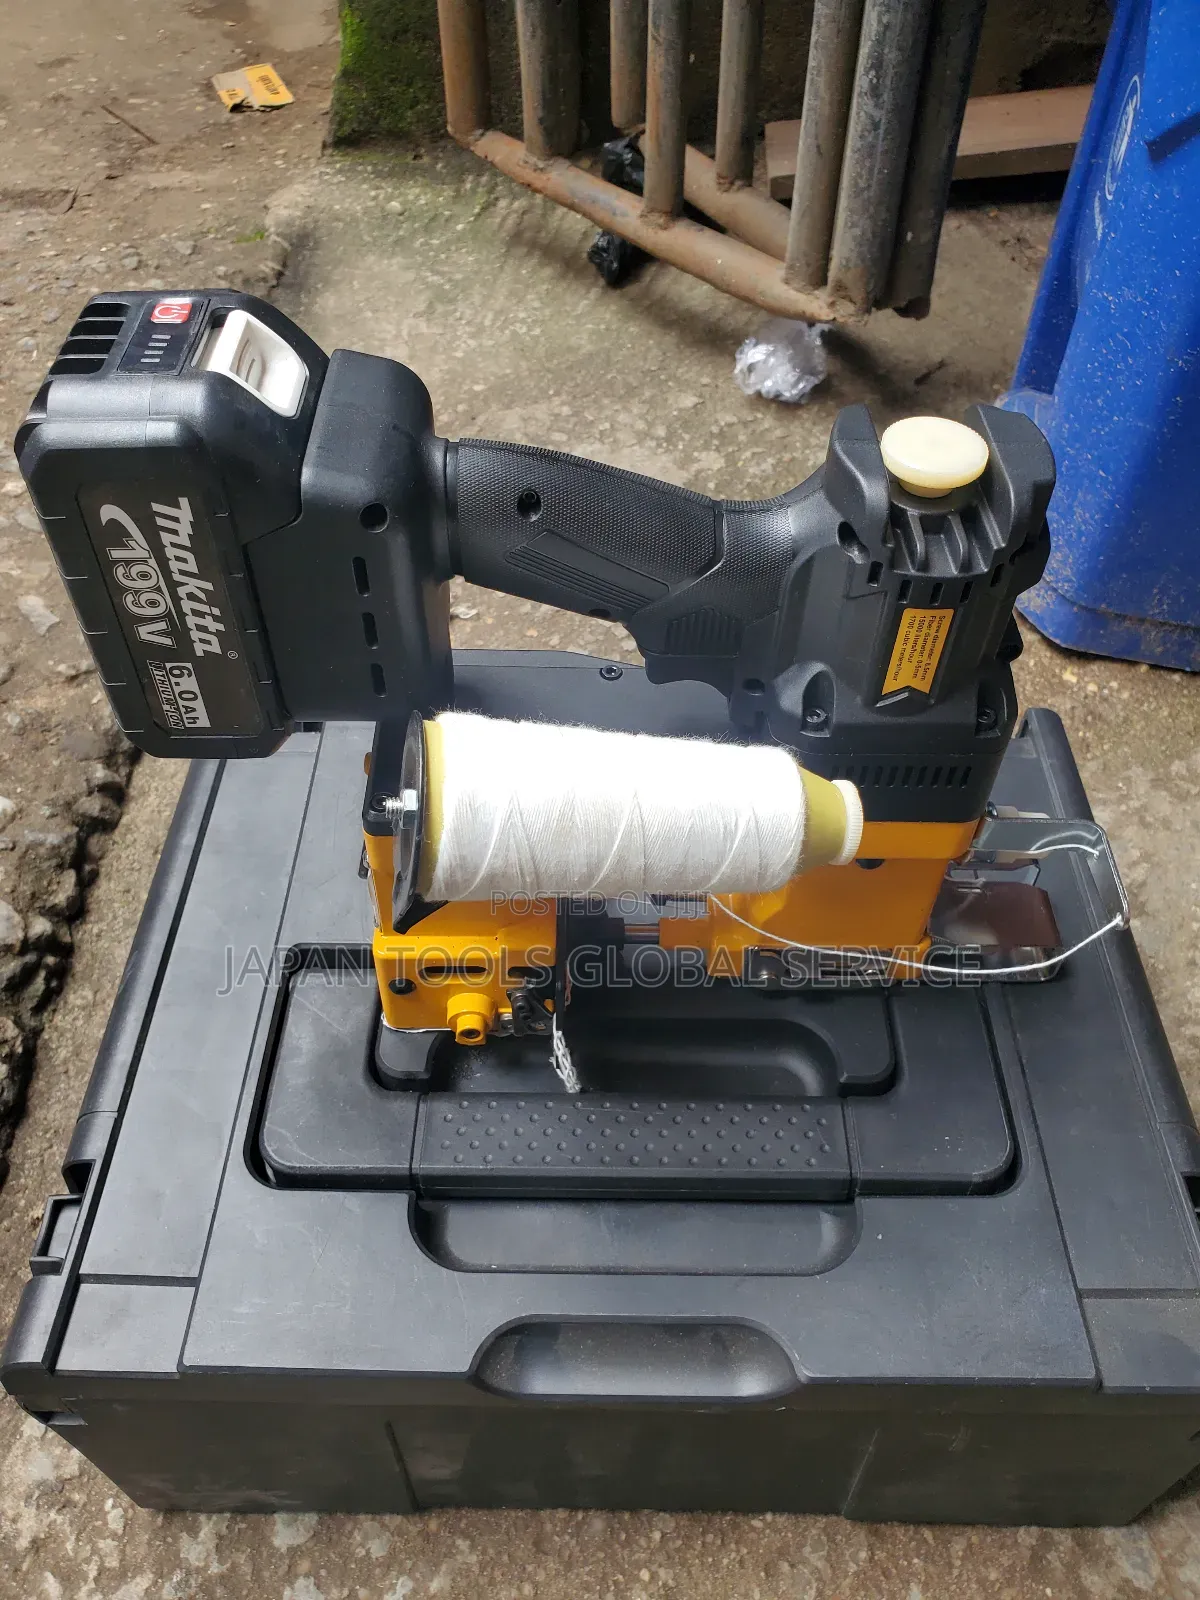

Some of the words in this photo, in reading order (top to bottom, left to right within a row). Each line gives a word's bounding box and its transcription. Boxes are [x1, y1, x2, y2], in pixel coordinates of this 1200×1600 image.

[106, 537, 177, 649] 199V
[907, 615, 917, 630] 1700
[927, 615, 937, 631] Fiber
[934, 615, 946, 633] Screw
[902, 630, 912, 646] cubic
[918, 631, 931, 659] diameter:
[167, 664, 201, 727] 6.0Ah
